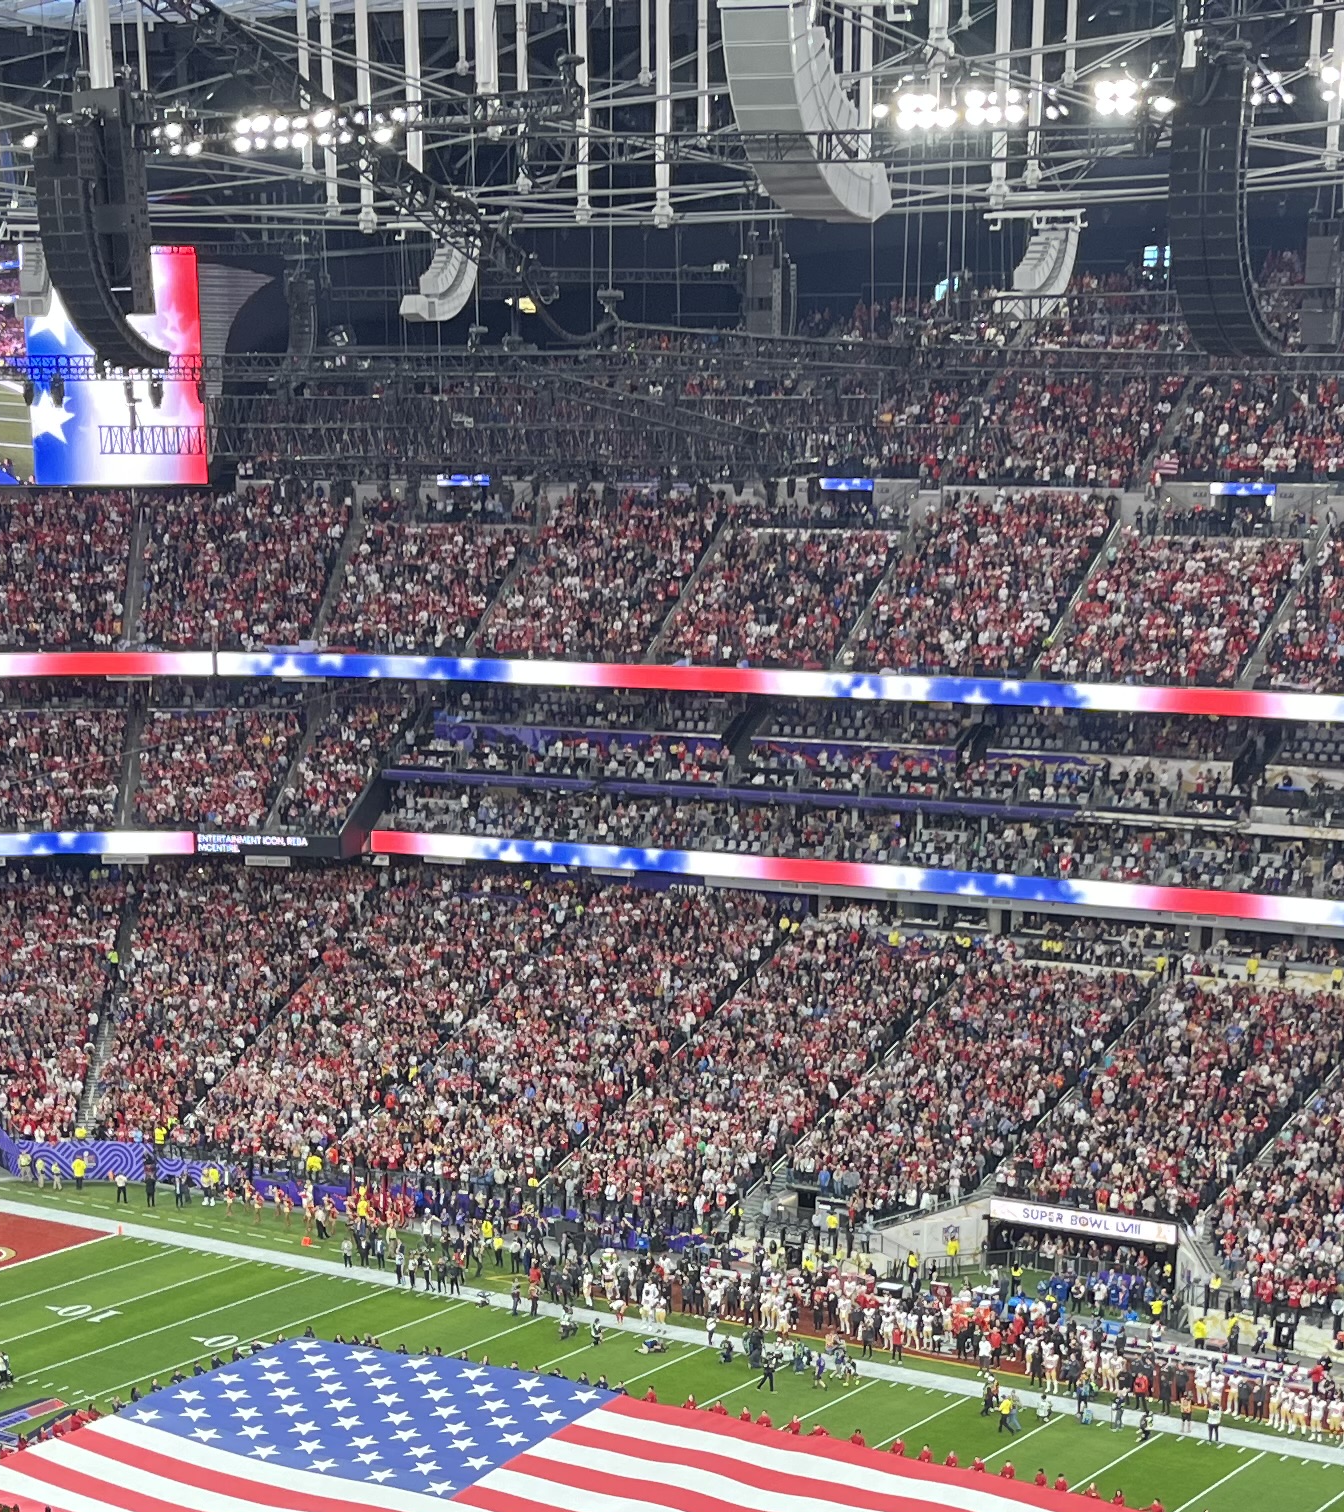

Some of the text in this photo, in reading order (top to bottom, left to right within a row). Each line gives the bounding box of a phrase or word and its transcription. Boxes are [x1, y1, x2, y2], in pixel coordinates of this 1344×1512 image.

[1022, 1207, 1141, 1235] SUPER BOWL LVIII
